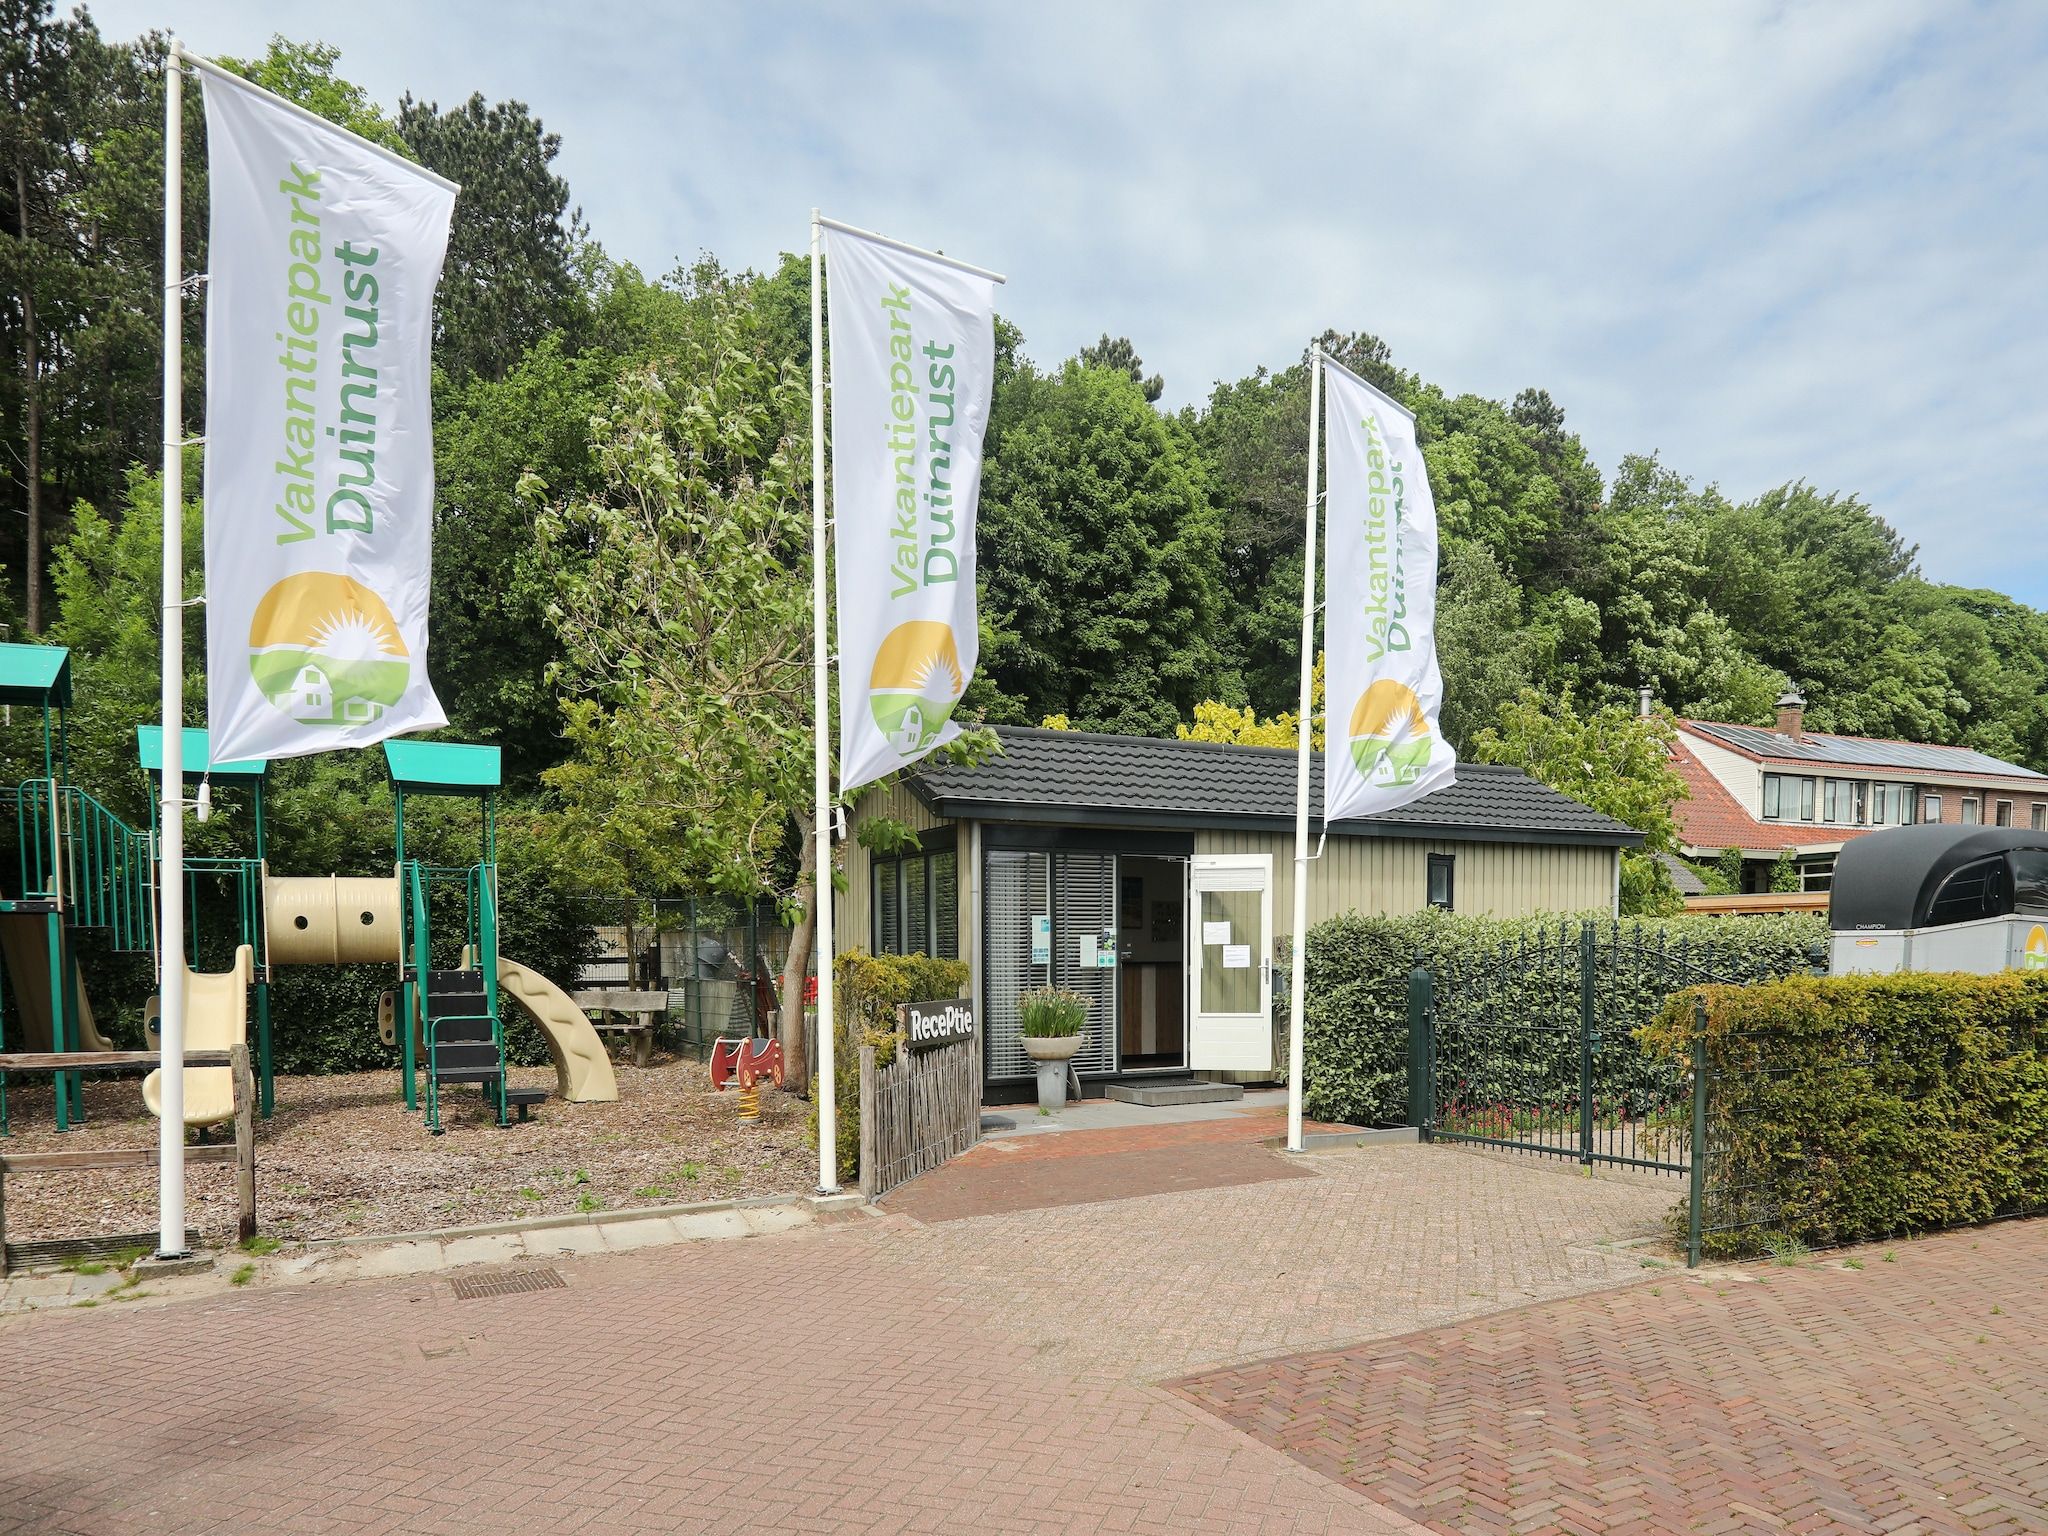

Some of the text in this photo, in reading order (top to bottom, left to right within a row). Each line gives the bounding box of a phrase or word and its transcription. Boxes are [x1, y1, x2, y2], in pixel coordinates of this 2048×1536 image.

[275, 160, 333, 546] Vakantiepark
[326, 240, 380, 535] Duinrust
[881, 281, 920, 600] Vakantiepark
[922, 339, 959, 587] Duinrust
[1361, 415, 1391, 663] Vakantiepark
